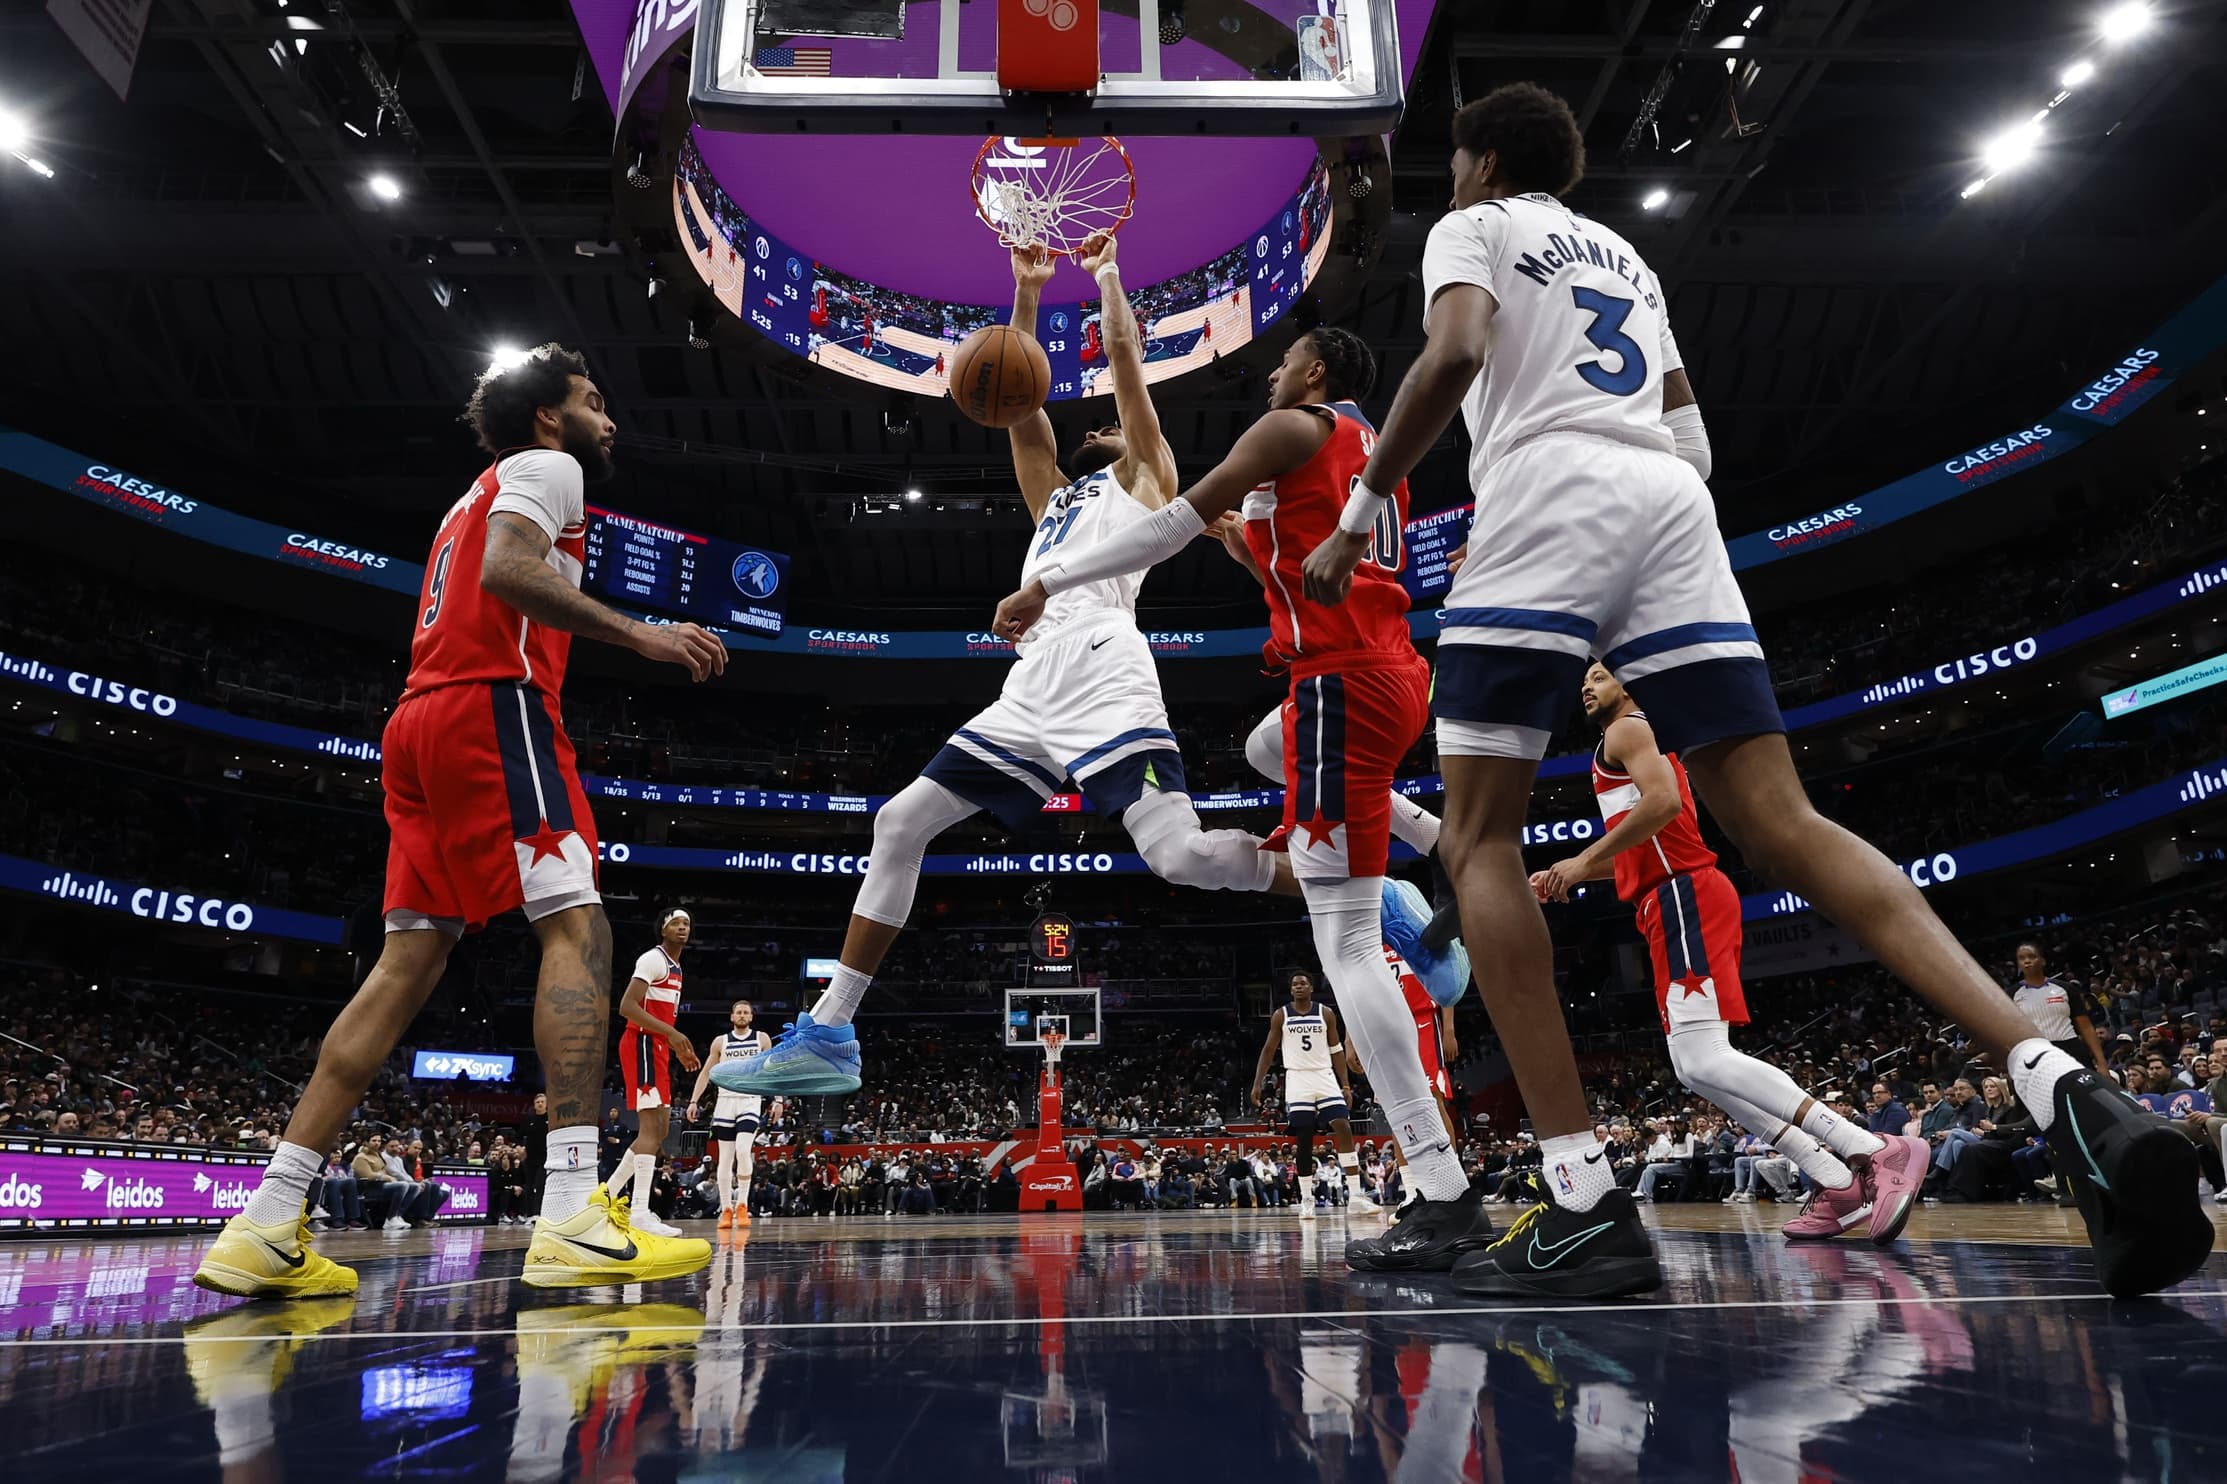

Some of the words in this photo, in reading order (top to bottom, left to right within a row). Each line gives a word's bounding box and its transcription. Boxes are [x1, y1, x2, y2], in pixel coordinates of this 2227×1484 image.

[1282, 240, 1292, 259] 53
[753, 265, 766, 281] 41
[1257, 263, 1268, 279] 41
[1514, 233, 1658, 311] McDANIELS
[783, 284, 798, 301] 53
[751, 309, 772, 330] 5:25
[1261, 302, 1279, 323] 5:25
[785, 333, 801, 346] :15
[1049, 340, 1065, 352] 53
[1571, 285, 1647, 396] 3
[2071, 347, 2160, 411] CAESARS
[1054, 382, 1073, 393] :15
[1945, 424, 2053, 474] CAESARS
[75, 474, 168, 515] SPORTSBOOK
[87, 465, 198, 514] CAESARS
[1418, 508, 1465, 531] MATCHUP
[1768, 503, 1863, 541] CAESARS
[606, 514, 635, 530] GAME
[637, 522, 685, 544] MATCHUP
[1036, 505, 1083, 560] 27
[1418, 527, 1438, 540] POINTS
[634, 532, 655, 546] POINTS
[1412, 542, 1427, 554] FIELD
[1427, 539, 1441, 550] GOAL
[287, 534, 389, 568] CAESARS
[624, 542, 639, 554] FIELD
[639, 546, 655, 558] GOAL
[627, 556, 641, 567] 3-PT
[1417, 553, 1431, 565] 3-PT
[624, 568, 656, 583] REBOUNDS
[1417, 561, 1447, 577] REBOUNDS
[422, 536, 454, 629] 9
[626, 582, 651, 595] ASSISTS
[681, 583, 690, 592] 20
[1422, 575, 1445, 589] ASSISTS
[731, 610, 781, 631] TIMBERWOLVES
[749, 606, 781, 620] MINNESOTA
[808, 629, 890, 644] CAESARS
[1146, 633, 1205, 643] ESARS
[807, 640, 877, 650] SPORTSBOOK
[1934, 636, 2037, 684] CISCO
[67, 671, 177, 716] CISCO
[603, 786, 628, 797] 18/35
[642, 790, 661, 801] 5/13
[678, 794, 692, 803] 0/1
[1402, 786, 1421, 796] 4/19
[713, 796, 719, 804] 9
[735, 797, 745, 806] 19
[782, 800, 788, 808] 4
[803, 801, 808, 809] 5
[828, 802, 868, 812] WIZARDS
[1193, 798, 1258, 809] TIMBERWOLVES
[1263, 797, 1269, 805] 6
[1522, 819, 1593, 845] ISCO
[1029, 854, 1112, 872] CISCO
[131, 887, 254, 931] CISCO
[1044, 923, 1069, 936] 5:24
[1752, 923, 1811, 946] VAULTS
[1048, 936, 1066, 957] 15
[1288, 1026, 1322, 1034] WOLVES
[1302, 1035, 1312, 1052] 5
[725, 1049, 758, 1057] WOLVES
[106, 1176, 164, 1208] leidos
[212, 1180, 258, 1208] leido
[451, 1187, 478, 1209] leidos
